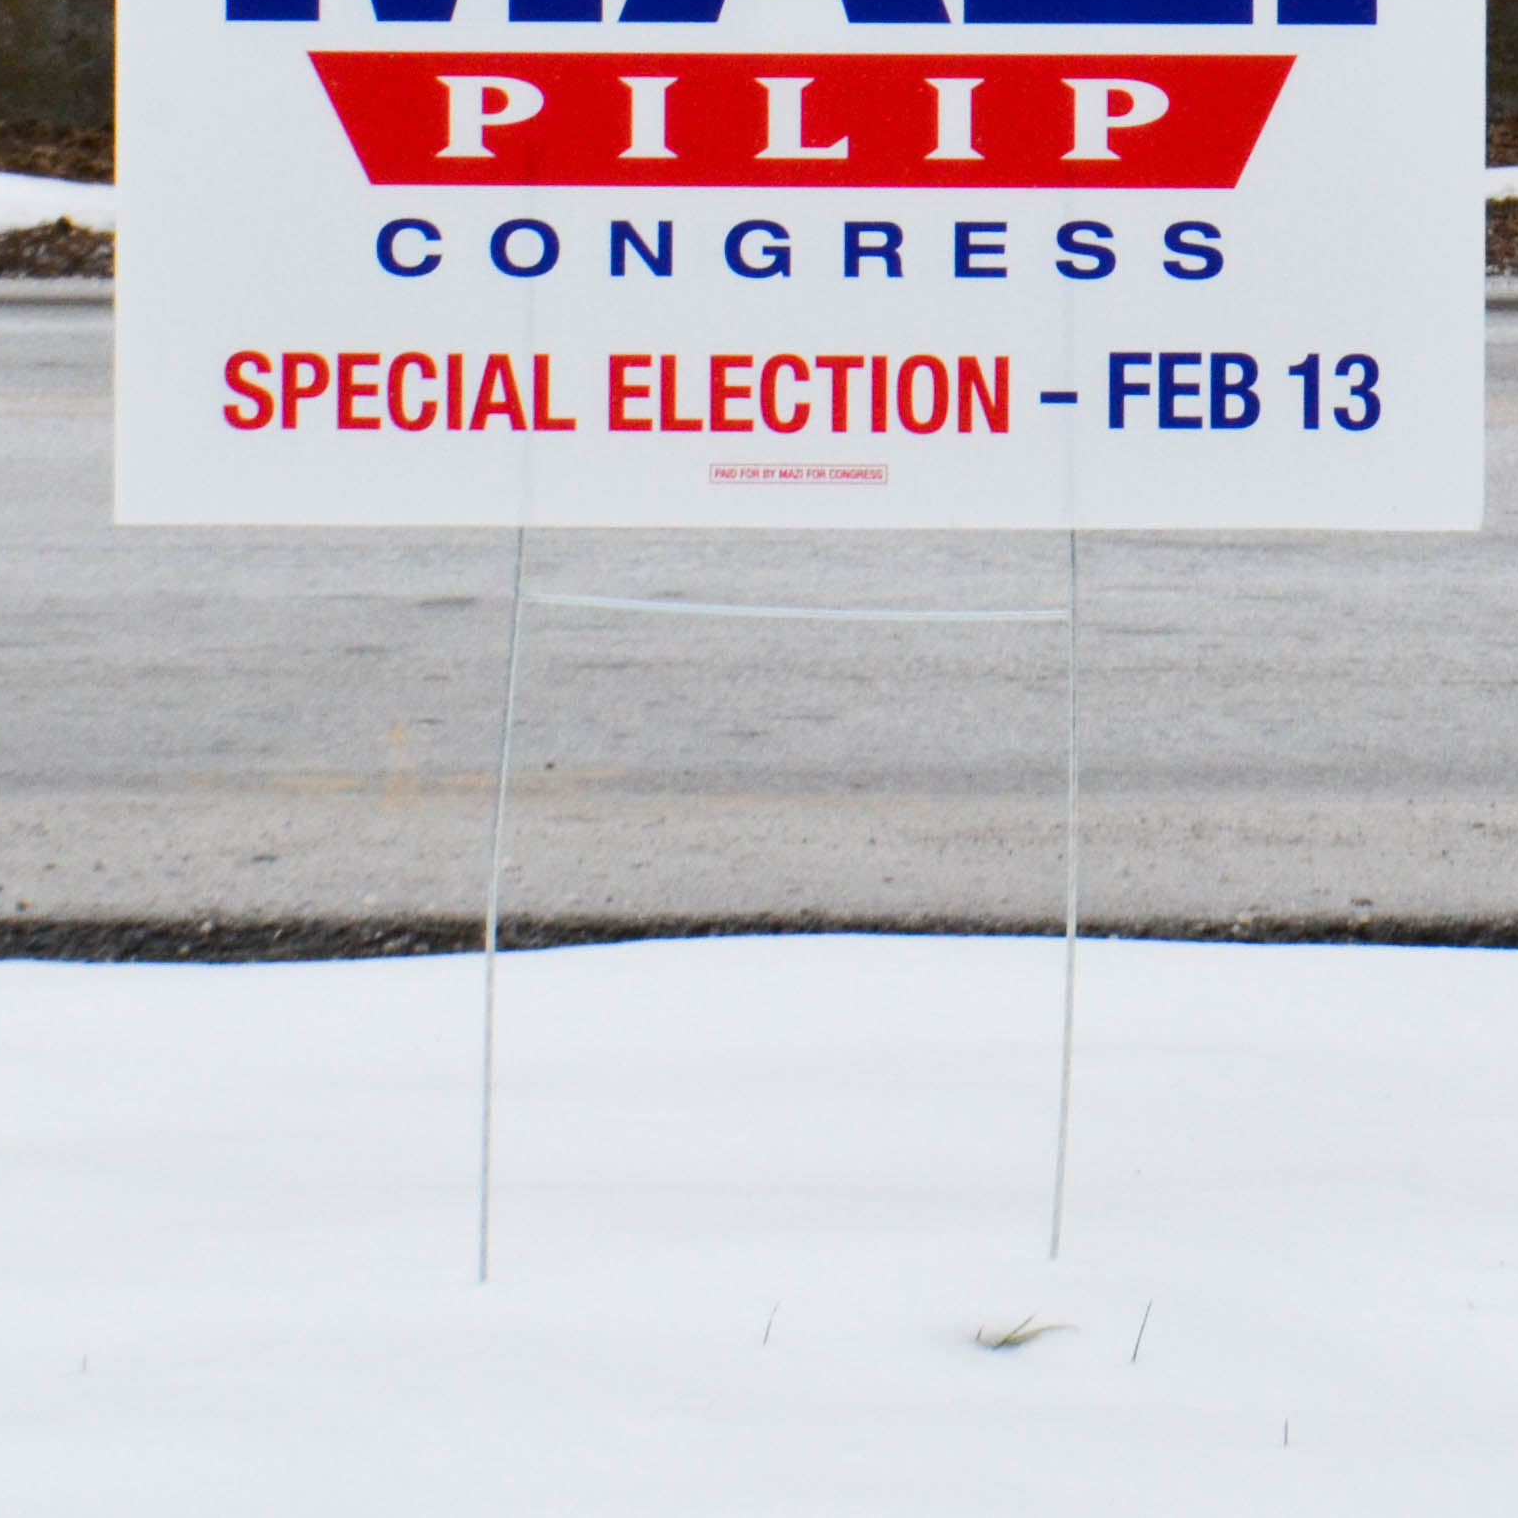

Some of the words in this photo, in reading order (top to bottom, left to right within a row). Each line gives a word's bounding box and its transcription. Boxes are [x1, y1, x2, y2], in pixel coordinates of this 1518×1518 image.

[434, 73, 1171, 162] PILIP
[375, 217, 1227, 281] CONGRESS
[222, 349, 576, 431] SPECIAL
[607, 352, 1011, 435] ELECTION
[1107, 351, 1261, 431] FEB
[1287, 351, 1382, 432] 13
[714, 468, 737, 479] PAID
[740, 468, 760, 479] FOR
[763, 468, 776, 479] BY
[779, 468, 803, 479] MAZI
[806, 468, 826, 479] FOR
[829, 468, 883, 480] CONGRESS
